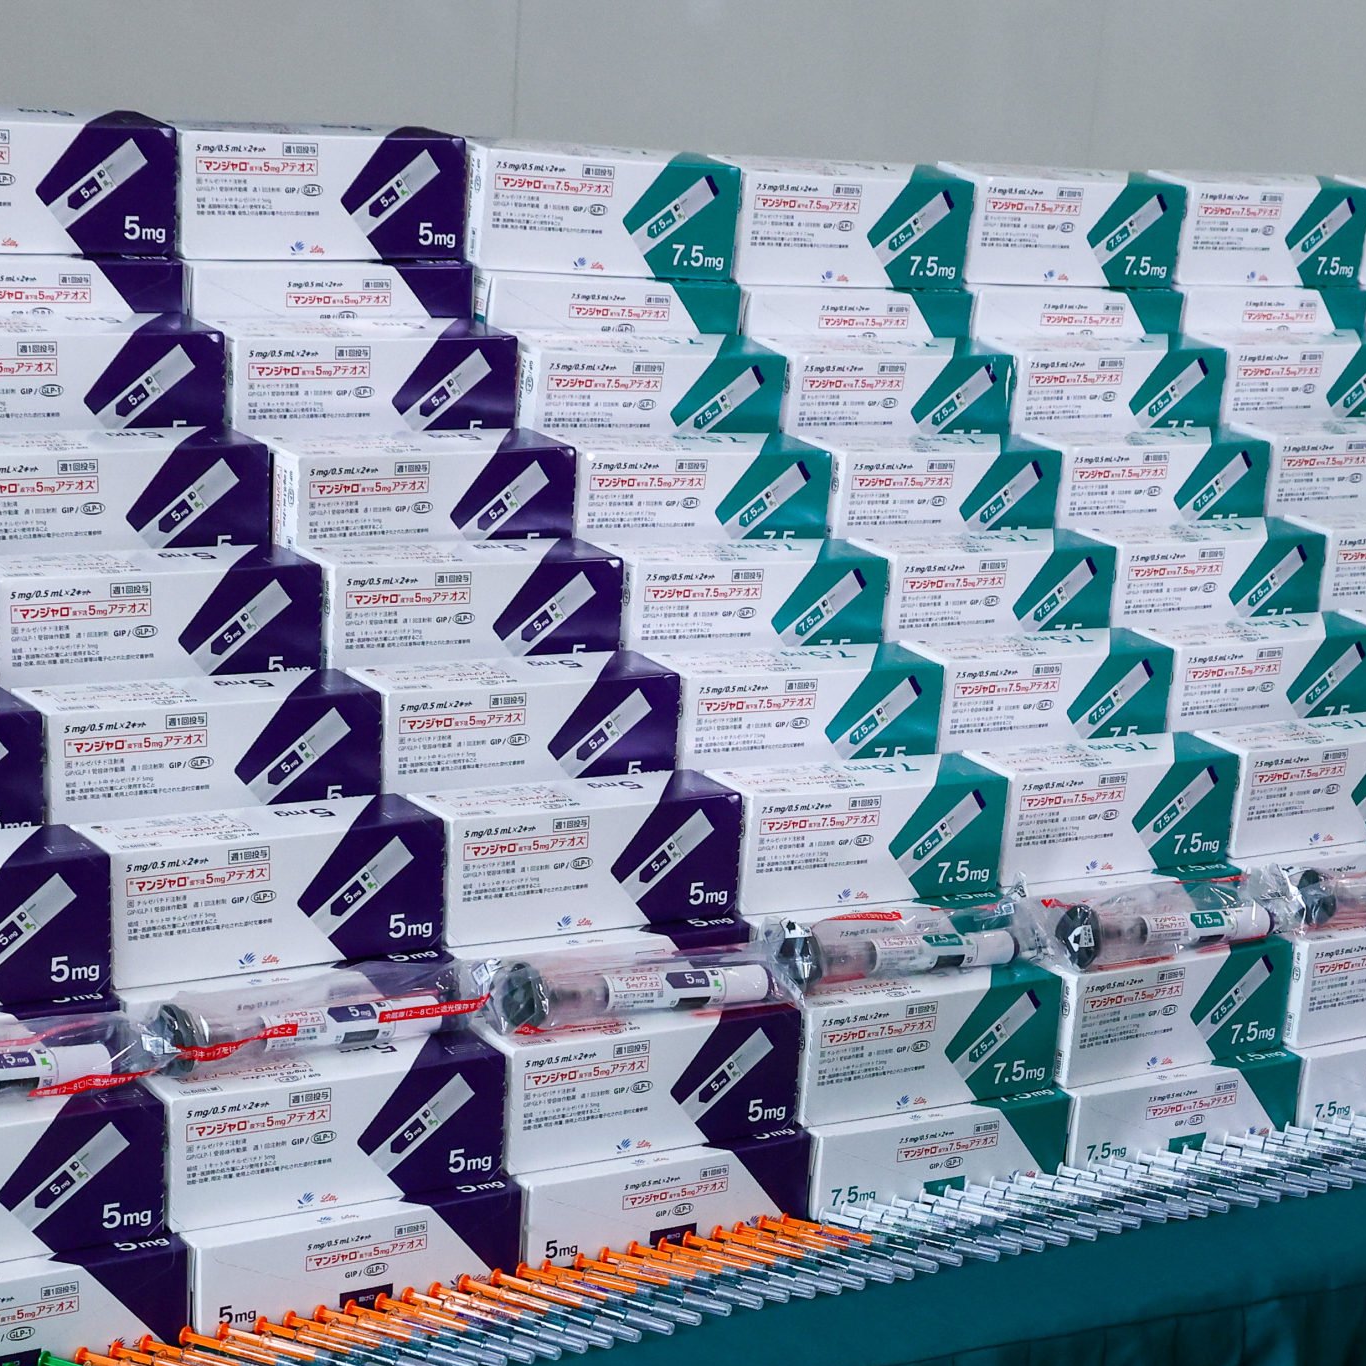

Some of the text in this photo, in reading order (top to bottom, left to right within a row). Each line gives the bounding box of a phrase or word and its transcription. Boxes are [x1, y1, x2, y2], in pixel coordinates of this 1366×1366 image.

[124, 216, 165, 243] 5mg
[419, 223, 455, 248] 5mg
[672, 244, 724, 271] 7.5mg
[910, 256, 956, 280] 7.5mg
[1125, 256, 1167, 279] 7.5mg
[1317, 257, 1354, 278] 7.5mg
[60, 462, 96, 472] 週1回投与
[1174, 833, 1220, 854] 7.5mg
[937, 860, 989, 883] 7.5mg
[689, 882, 727, 905] 5mg
[389, 914, 432, 938] 5mg
[51, 956, 100, 982] 5mg
[685, 973, 706, 985] 5mg
[351, 1005, 372, 1019] 5mg
[1231, 1021, 1276, 1044] 7.5mg
[994, 1060, 1045, 1084] 7.5mg
[748, 1099, 786, 1122] 5mg
[1315, 1103, 1350, 1118] 7.5mg
[448, 1149, 491, 1173] 5mg
[1086, 1142, 1126, 1160] 7.5mg
[102, 1203, 151, 1229] 5mg
[545, 1240, 578, 1259] 5mg
[218, 1305, 257, 1324] 5mg
